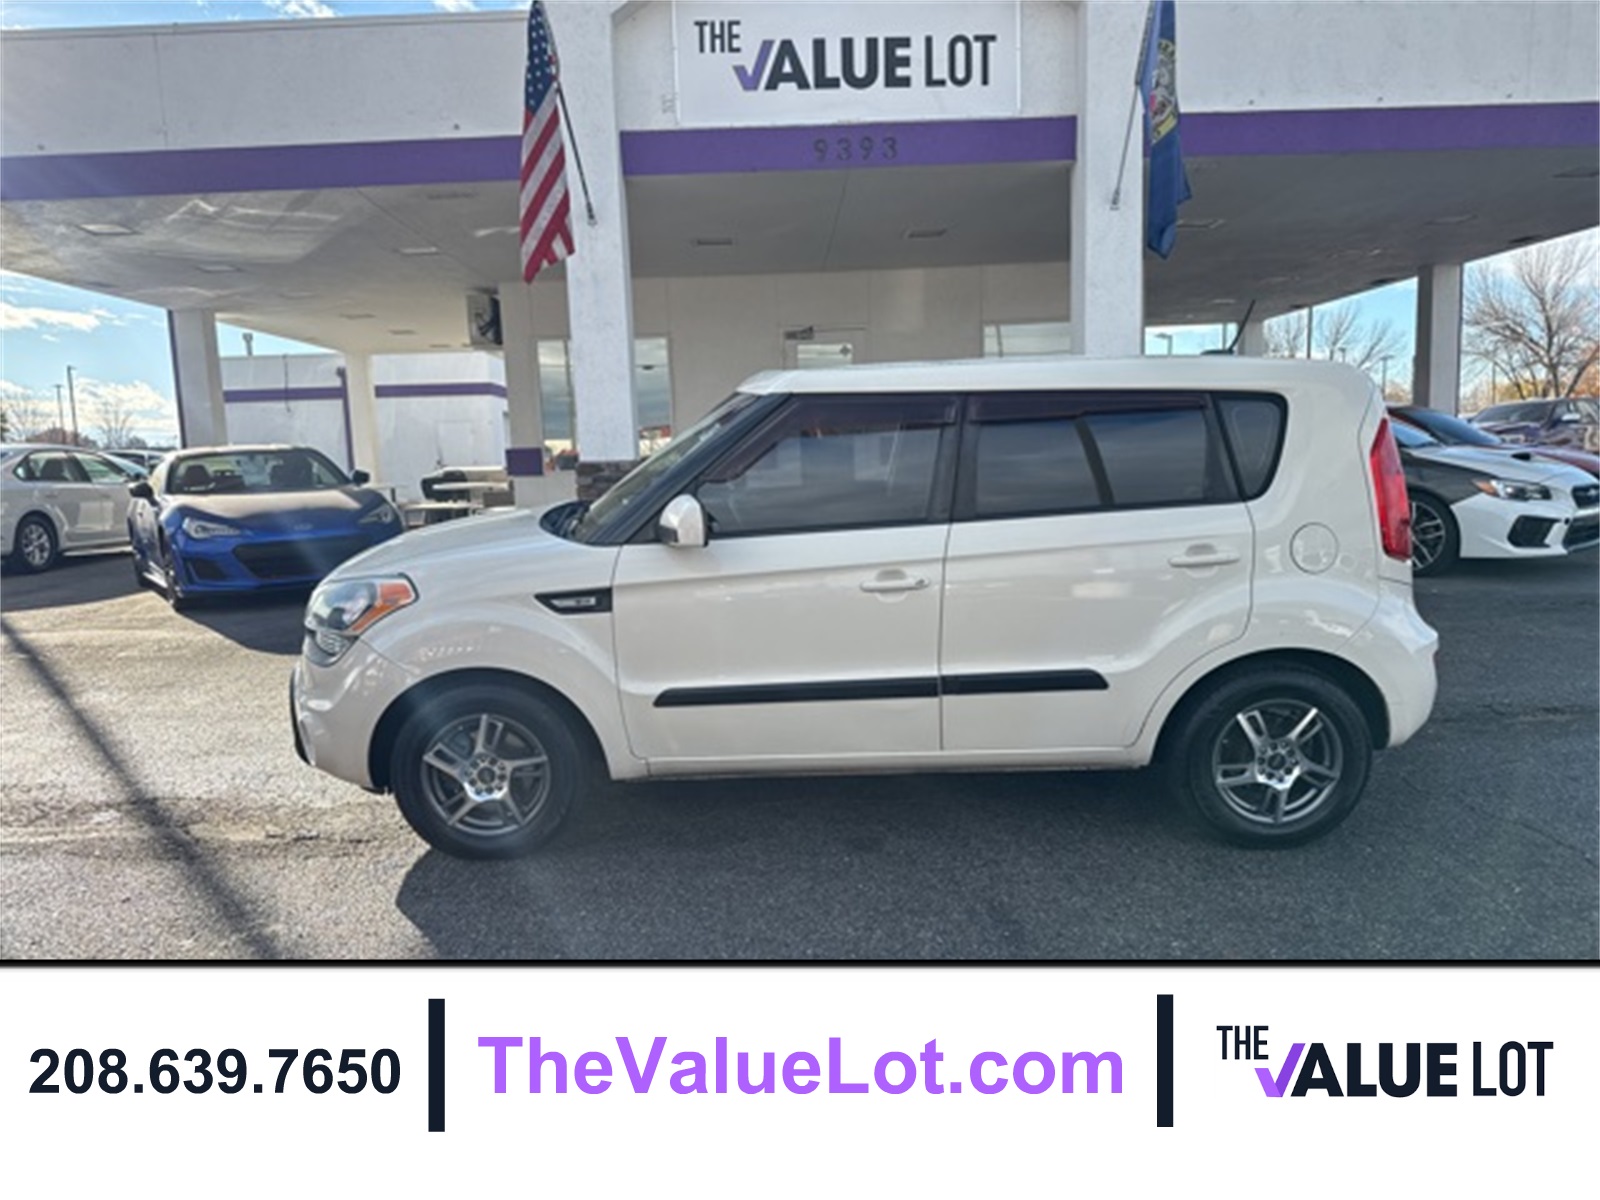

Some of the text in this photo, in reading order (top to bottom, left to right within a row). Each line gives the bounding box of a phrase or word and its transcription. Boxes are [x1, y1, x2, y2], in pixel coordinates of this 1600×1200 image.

[694, 19, 997, 92] THE VALUE LOT
[812, 135, 899, 162] 9393
